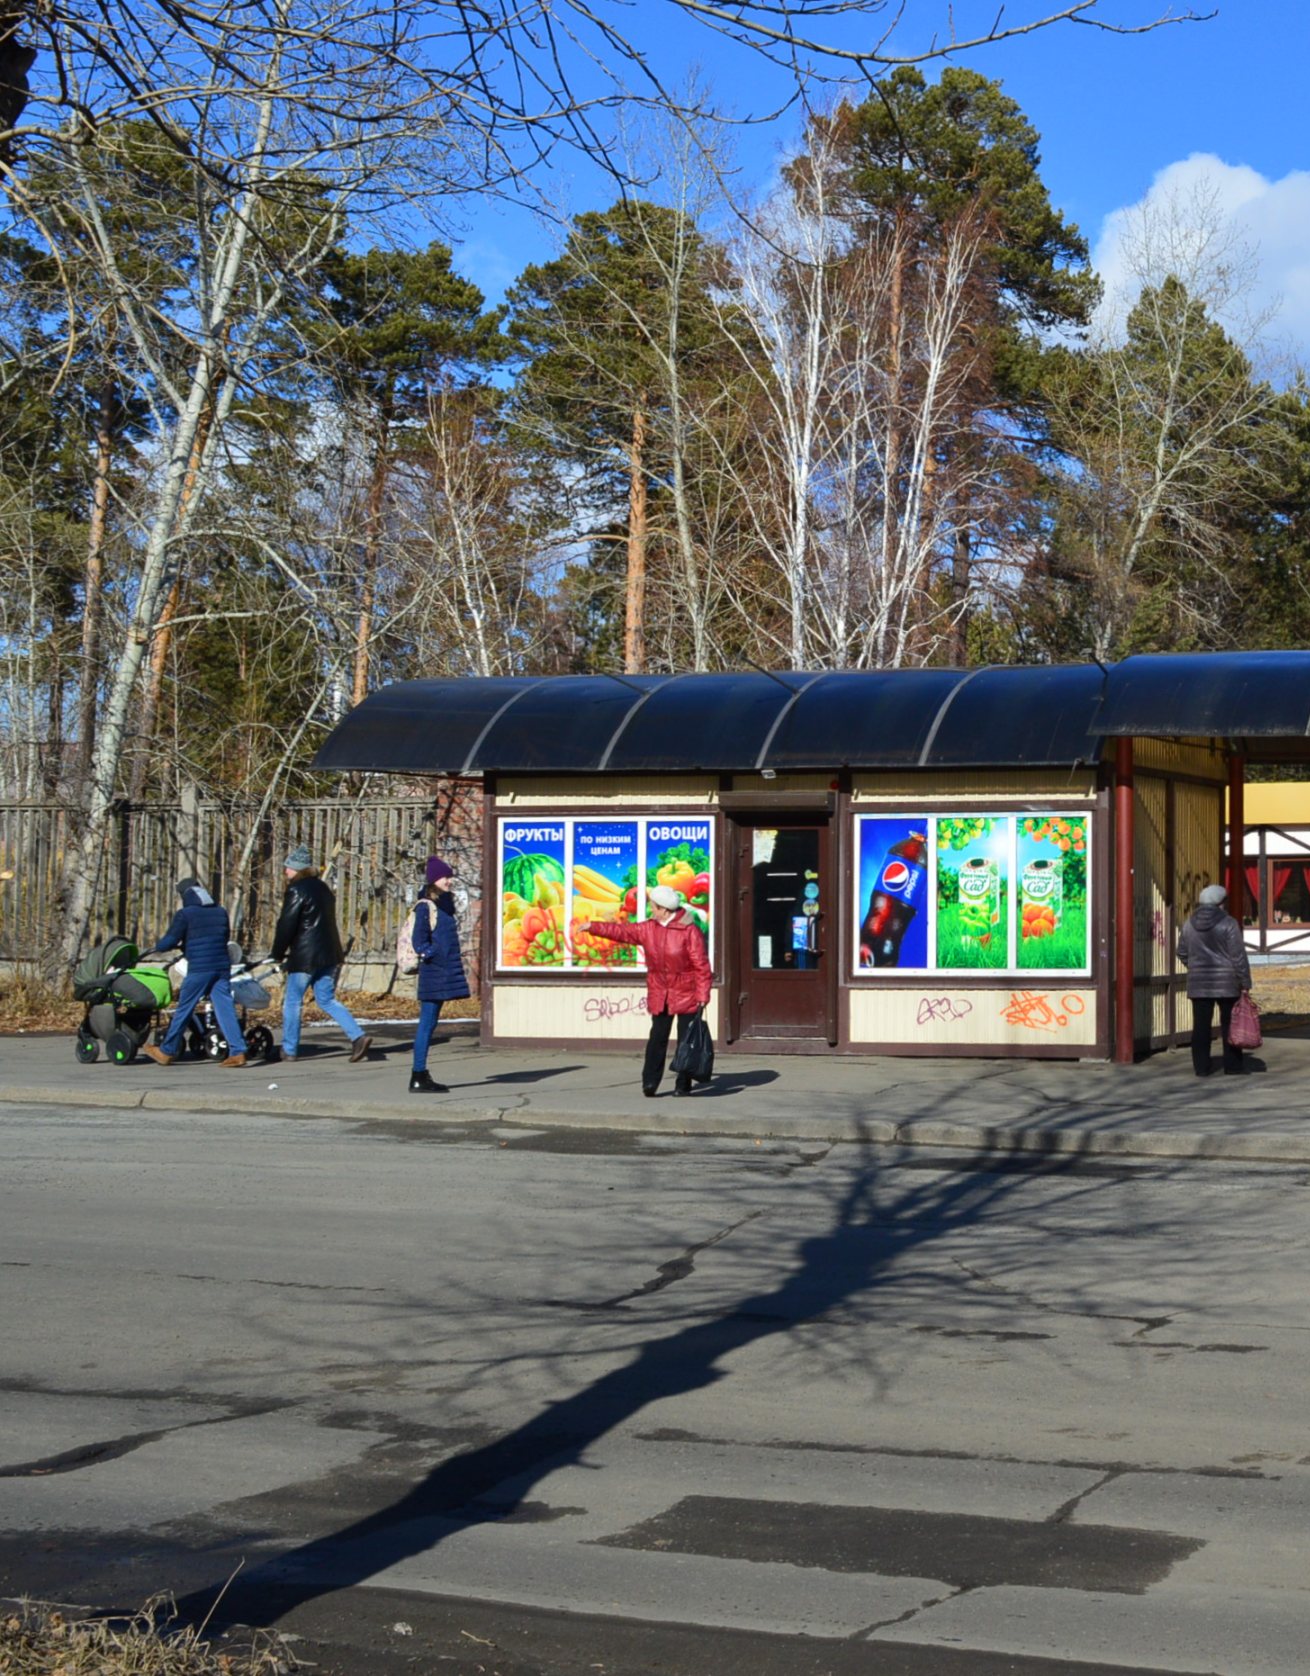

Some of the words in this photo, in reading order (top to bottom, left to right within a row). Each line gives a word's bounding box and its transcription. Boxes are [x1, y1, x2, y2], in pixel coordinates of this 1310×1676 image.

[504, 828, 564, 843] ФРУКТЫ
[649, 826, 708, 842] ОВОЩИ
[590, 847, 621, 856] ЦЕНАМ
